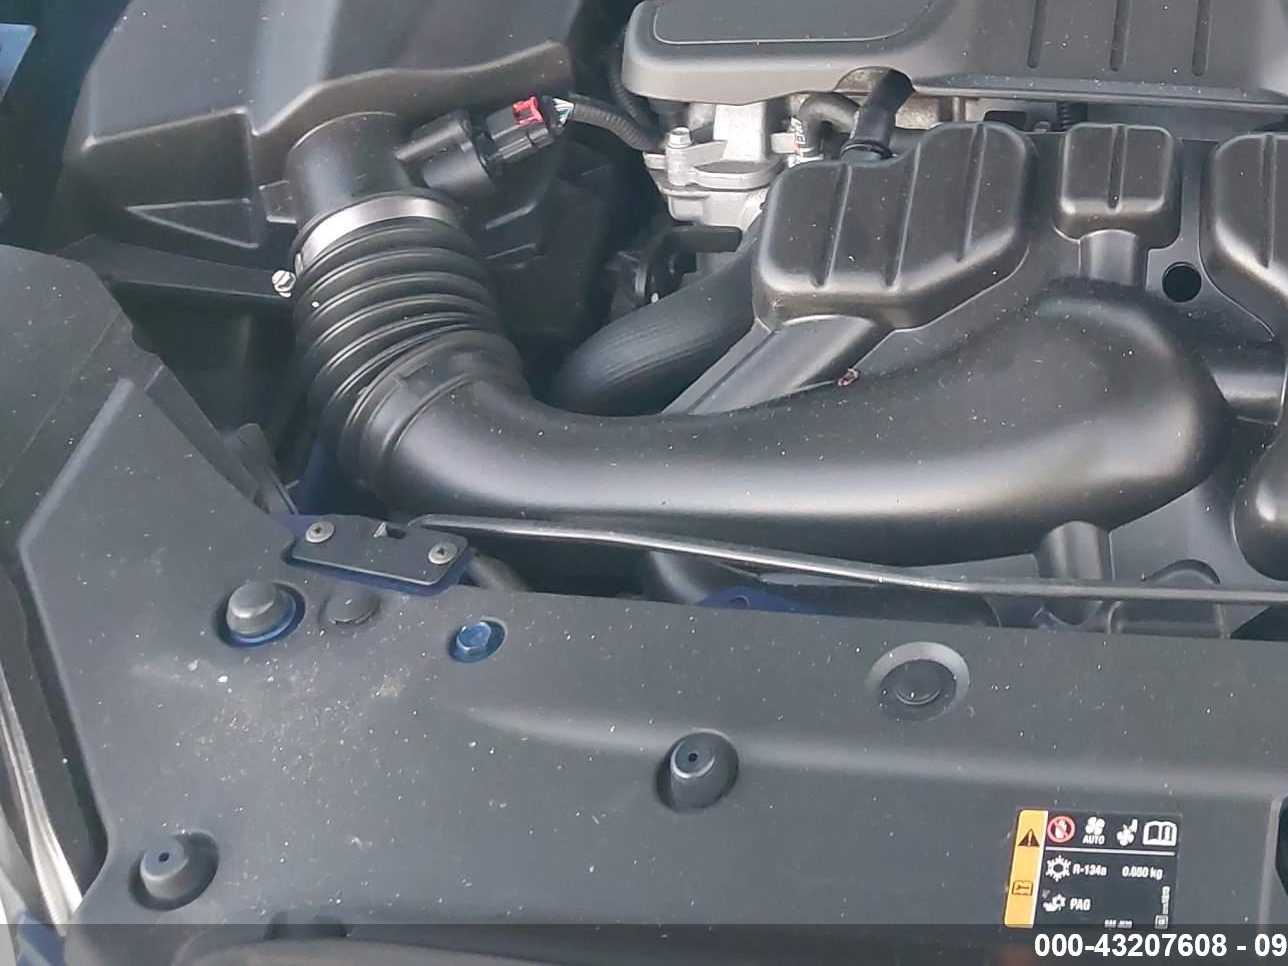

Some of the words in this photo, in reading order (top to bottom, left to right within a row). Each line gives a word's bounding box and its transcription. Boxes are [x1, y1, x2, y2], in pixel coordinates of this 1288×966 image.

[1082, 834, 1105, 845] AUTO
[1072, 863, 1107, 877] R-134a
[1149, 866, 1163, 881] kg
